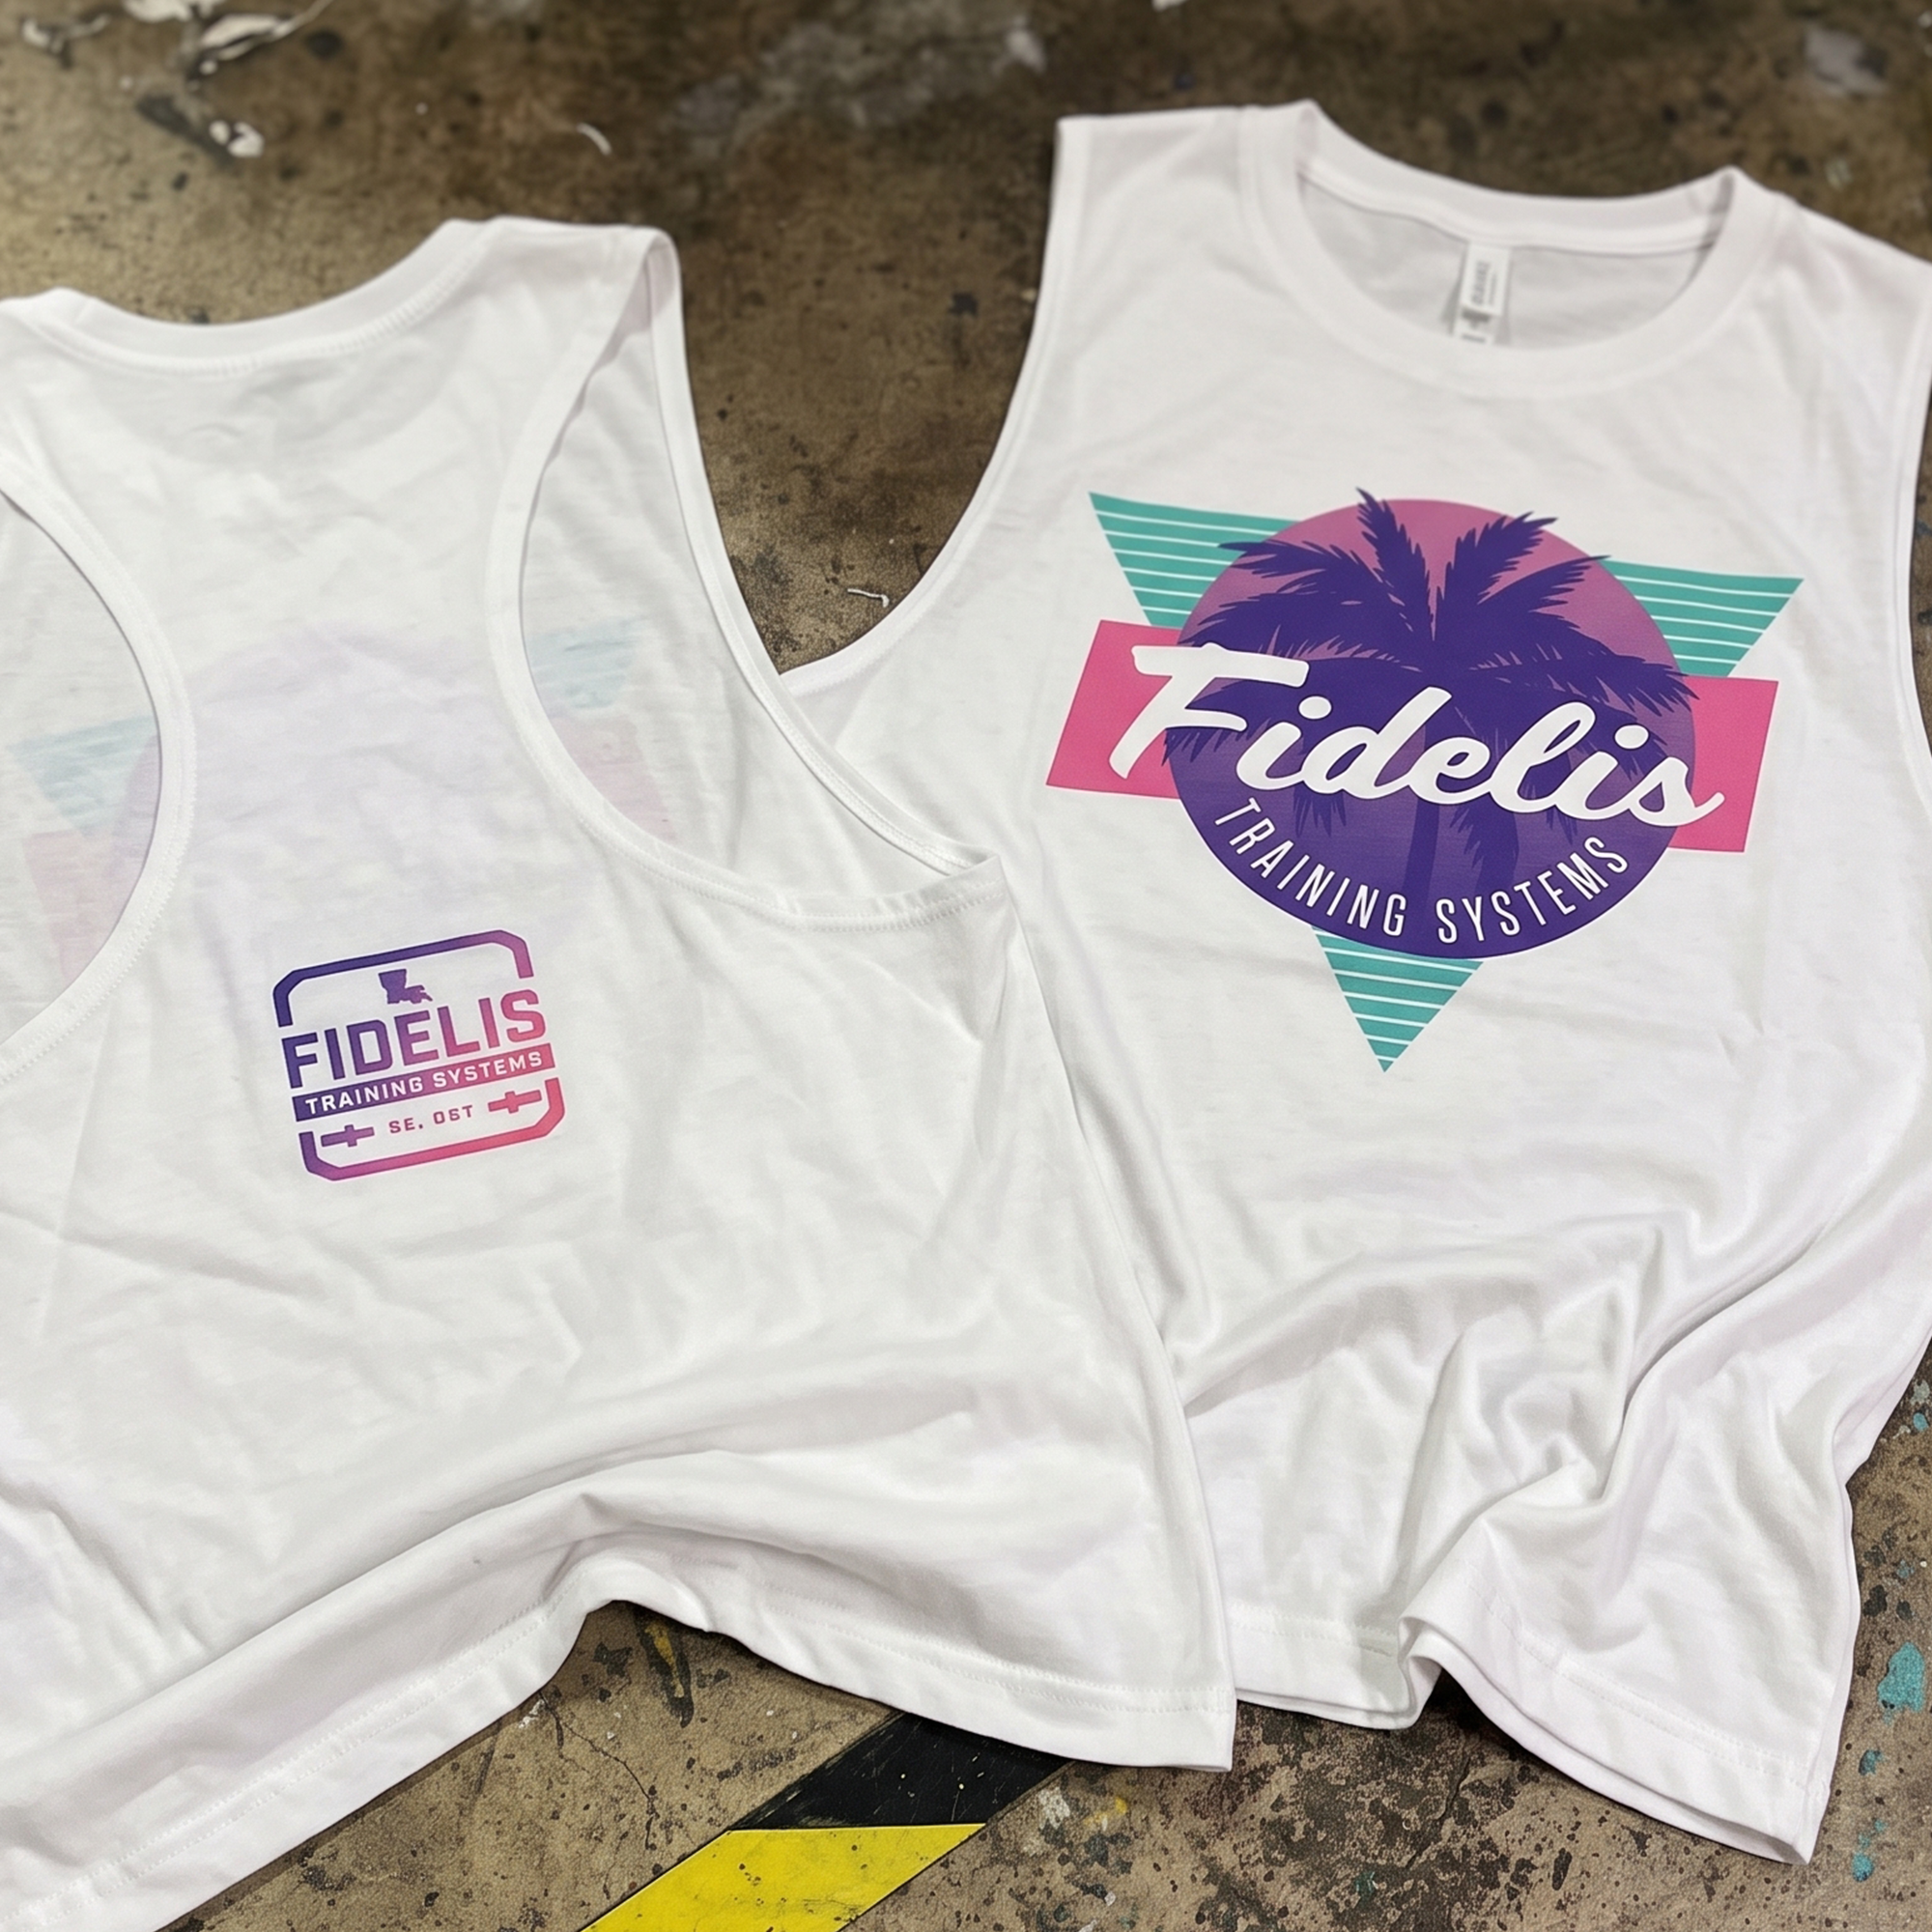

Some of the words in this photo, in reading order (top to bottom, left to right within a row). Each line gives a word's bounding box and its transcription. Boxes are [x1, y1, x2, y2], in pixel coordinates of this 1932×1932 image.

[1108, 642, 1725, 827] Fidelis
[1214, 797, 1407, 937] TRAINING
[1435, 836, 1629, 944] SYSTEMS
[281, 988, 546, 1089] FIDELIS
[305, 1076, 423, 1115] TRAINING
[433, 1051, 543, 1088] SYSTEMS
